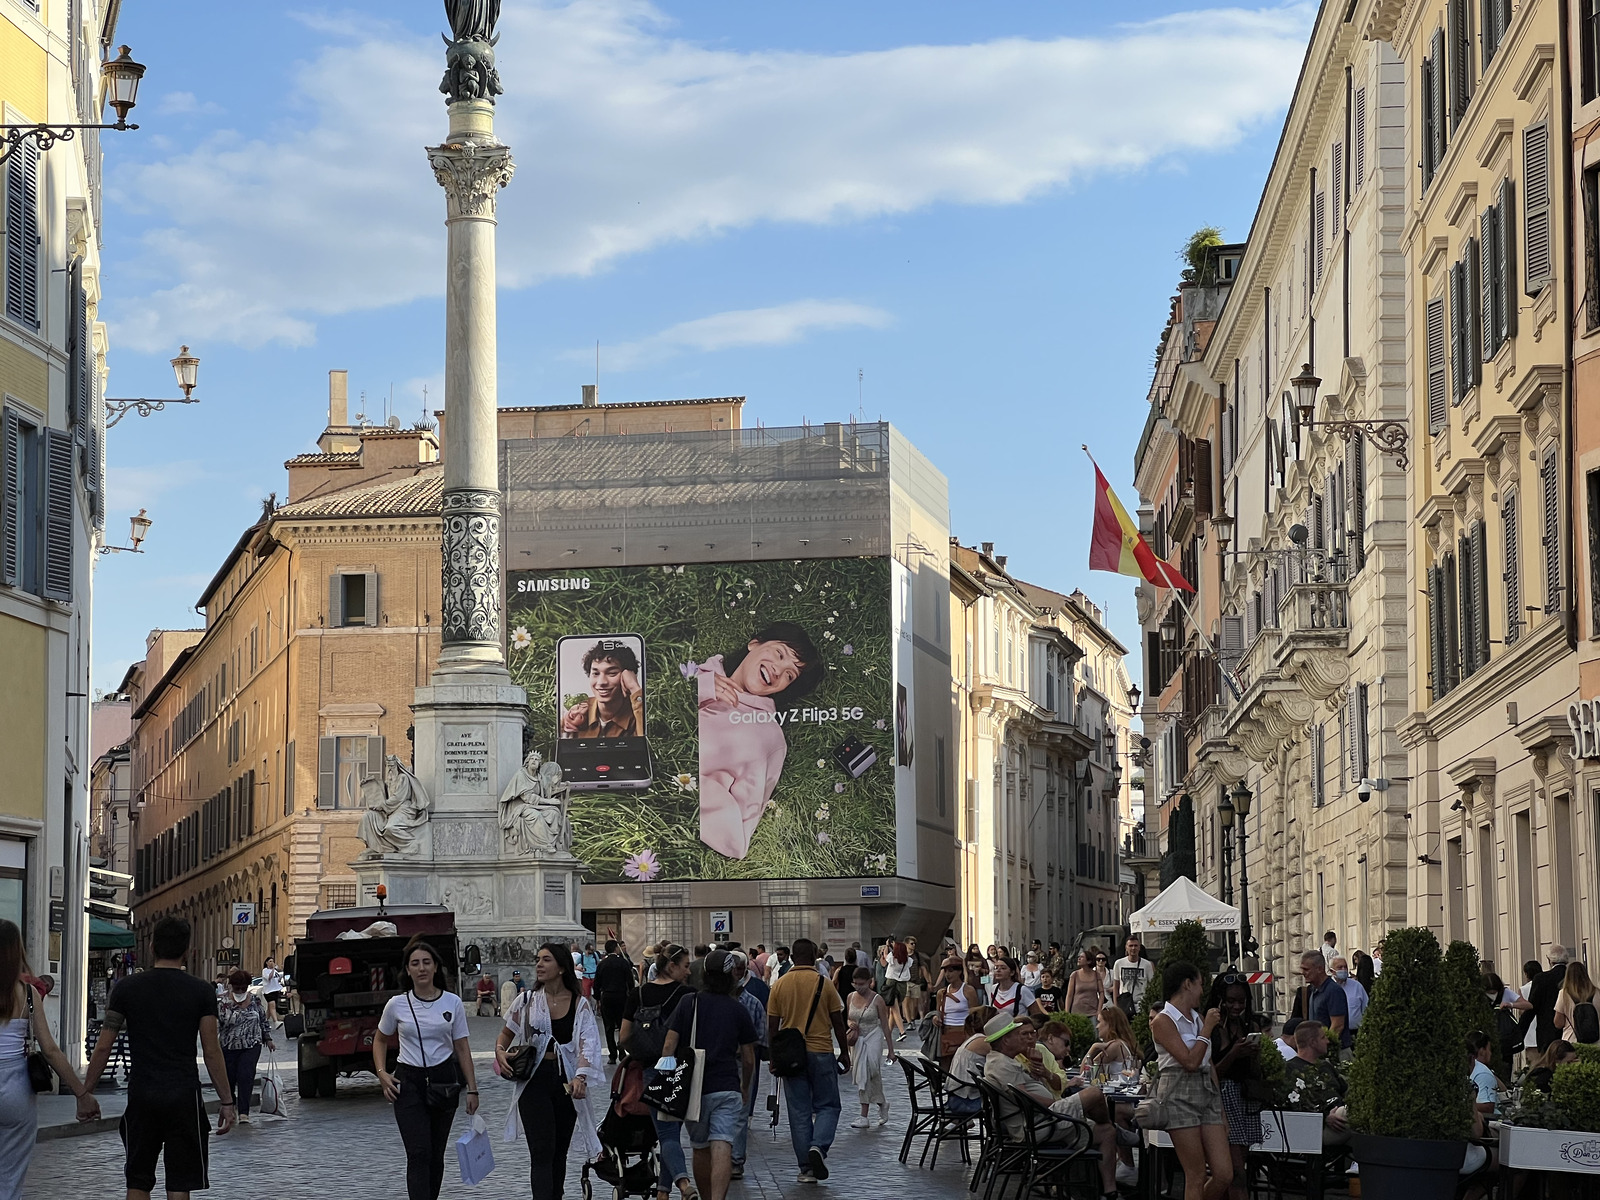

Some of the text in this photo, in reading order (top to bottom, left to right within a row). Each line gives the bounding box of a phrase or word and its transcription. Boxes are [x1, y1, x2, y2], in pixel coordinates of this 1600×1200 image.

[517, 577, 591, 593] SAMSUNG
[728, 706, 864, 726] Galaxy Z Flip3 5G
